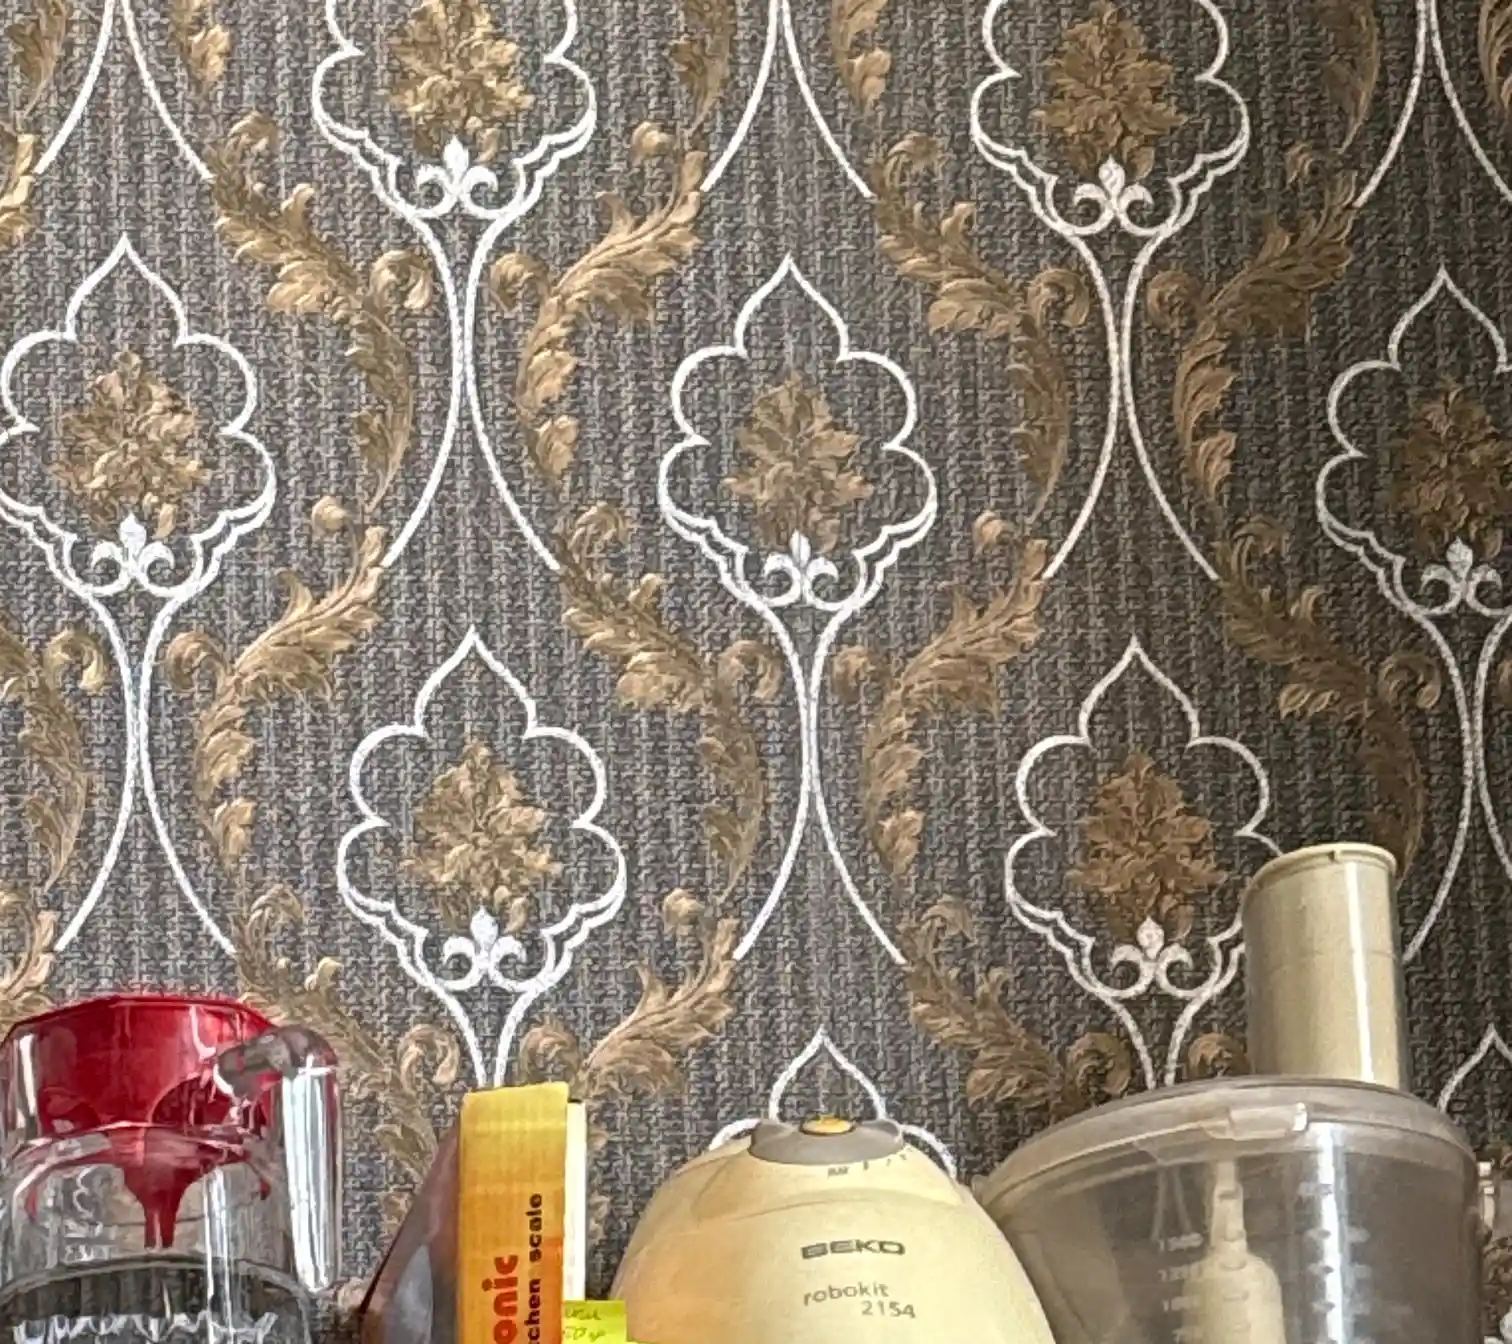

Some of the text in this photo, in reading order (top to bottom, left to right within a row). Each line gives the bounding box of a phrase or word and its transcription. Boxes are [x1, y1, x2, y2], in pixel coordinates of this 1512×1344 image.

[525, 1192, 543, 1264] scale
[800, 1239, 906, 1260] BEKO
[803, 1281, 889, 1307] robokit
[861, 1299, 917, 1319] 2154
